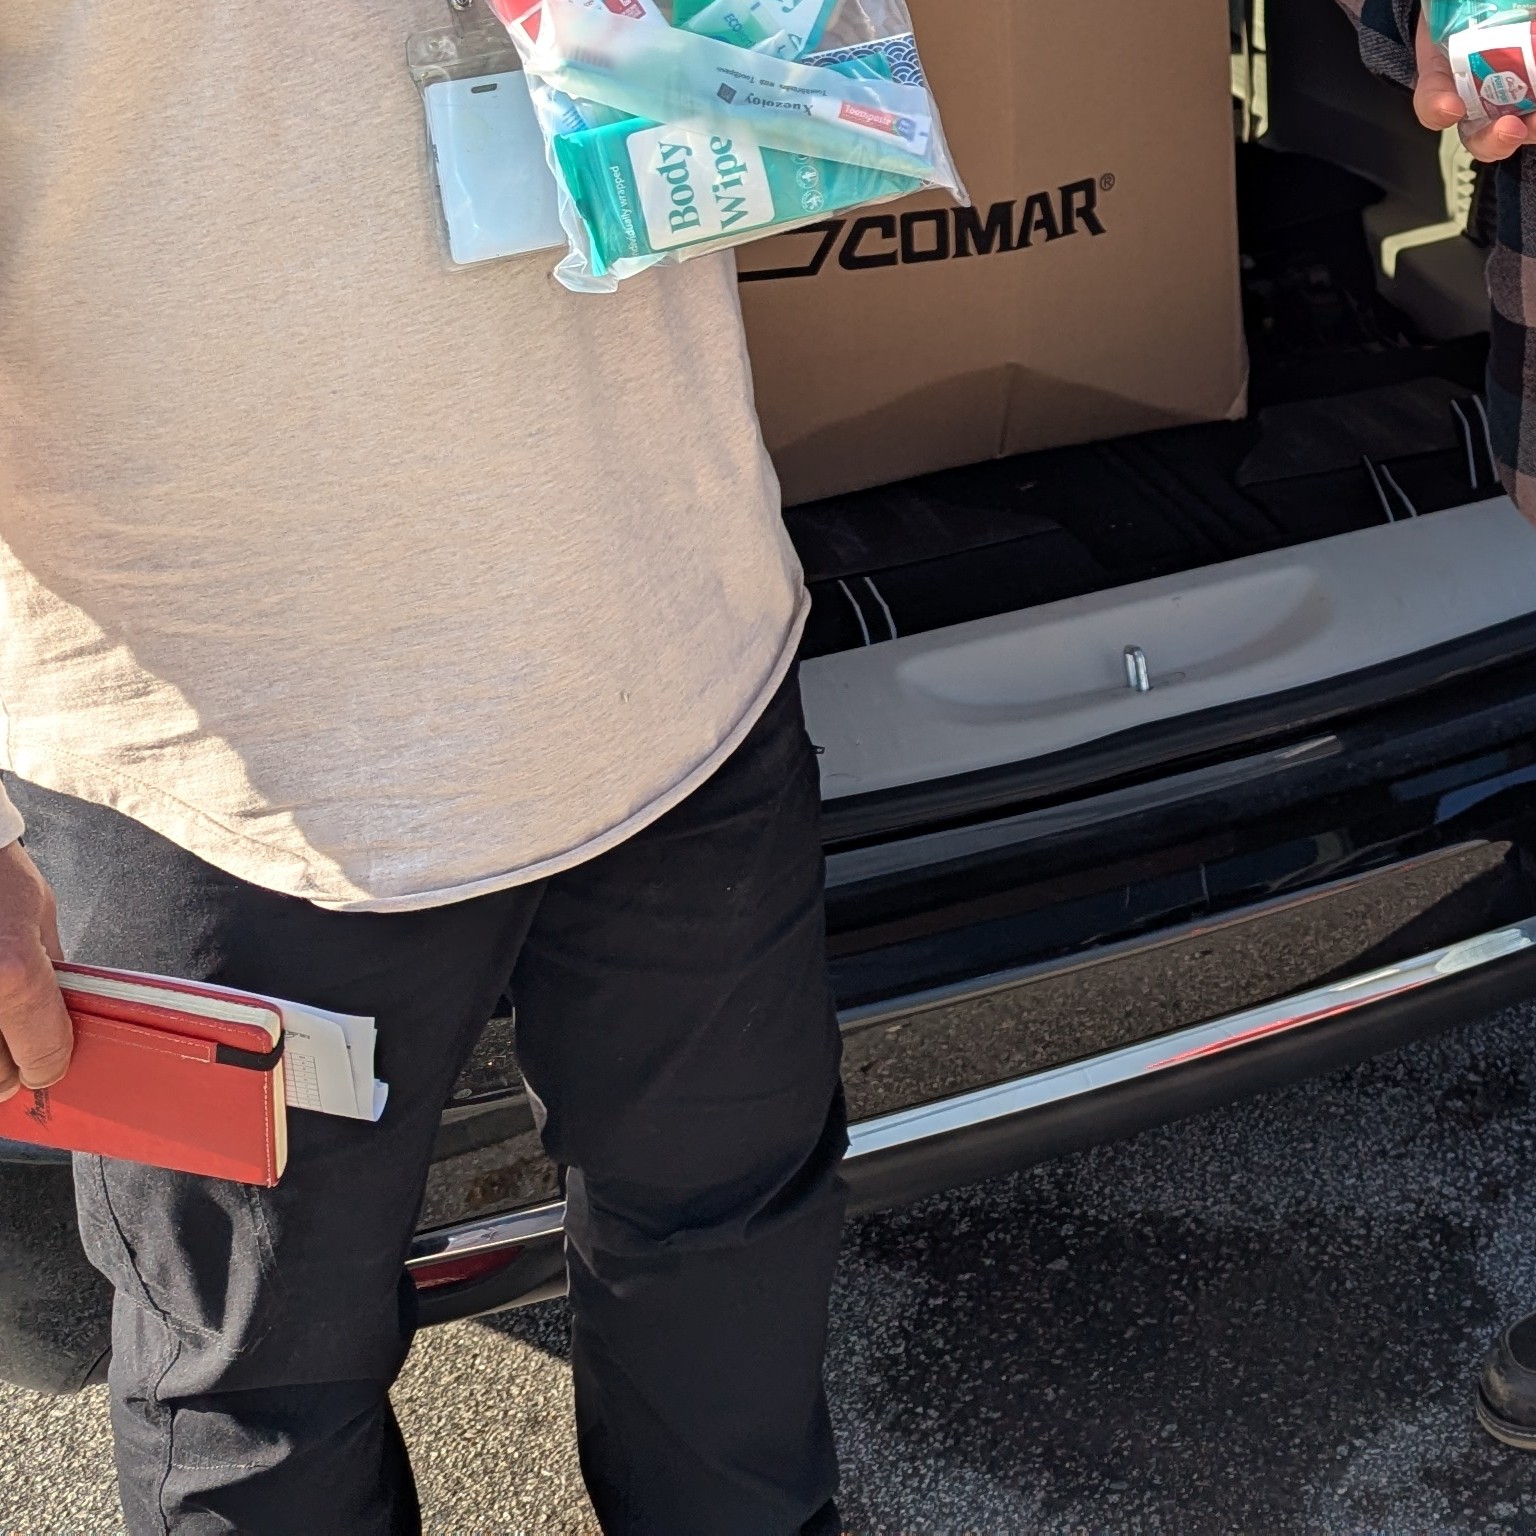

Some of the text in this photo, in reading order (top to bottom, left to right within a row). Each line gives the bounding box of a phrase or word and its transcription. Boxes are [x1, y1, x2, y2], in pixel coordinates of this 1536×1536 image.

[610, 165, 639, 257] ndividually wrapped
[656, 141, 702, 234] Body
[709, 135, 749, 231] Wipe
